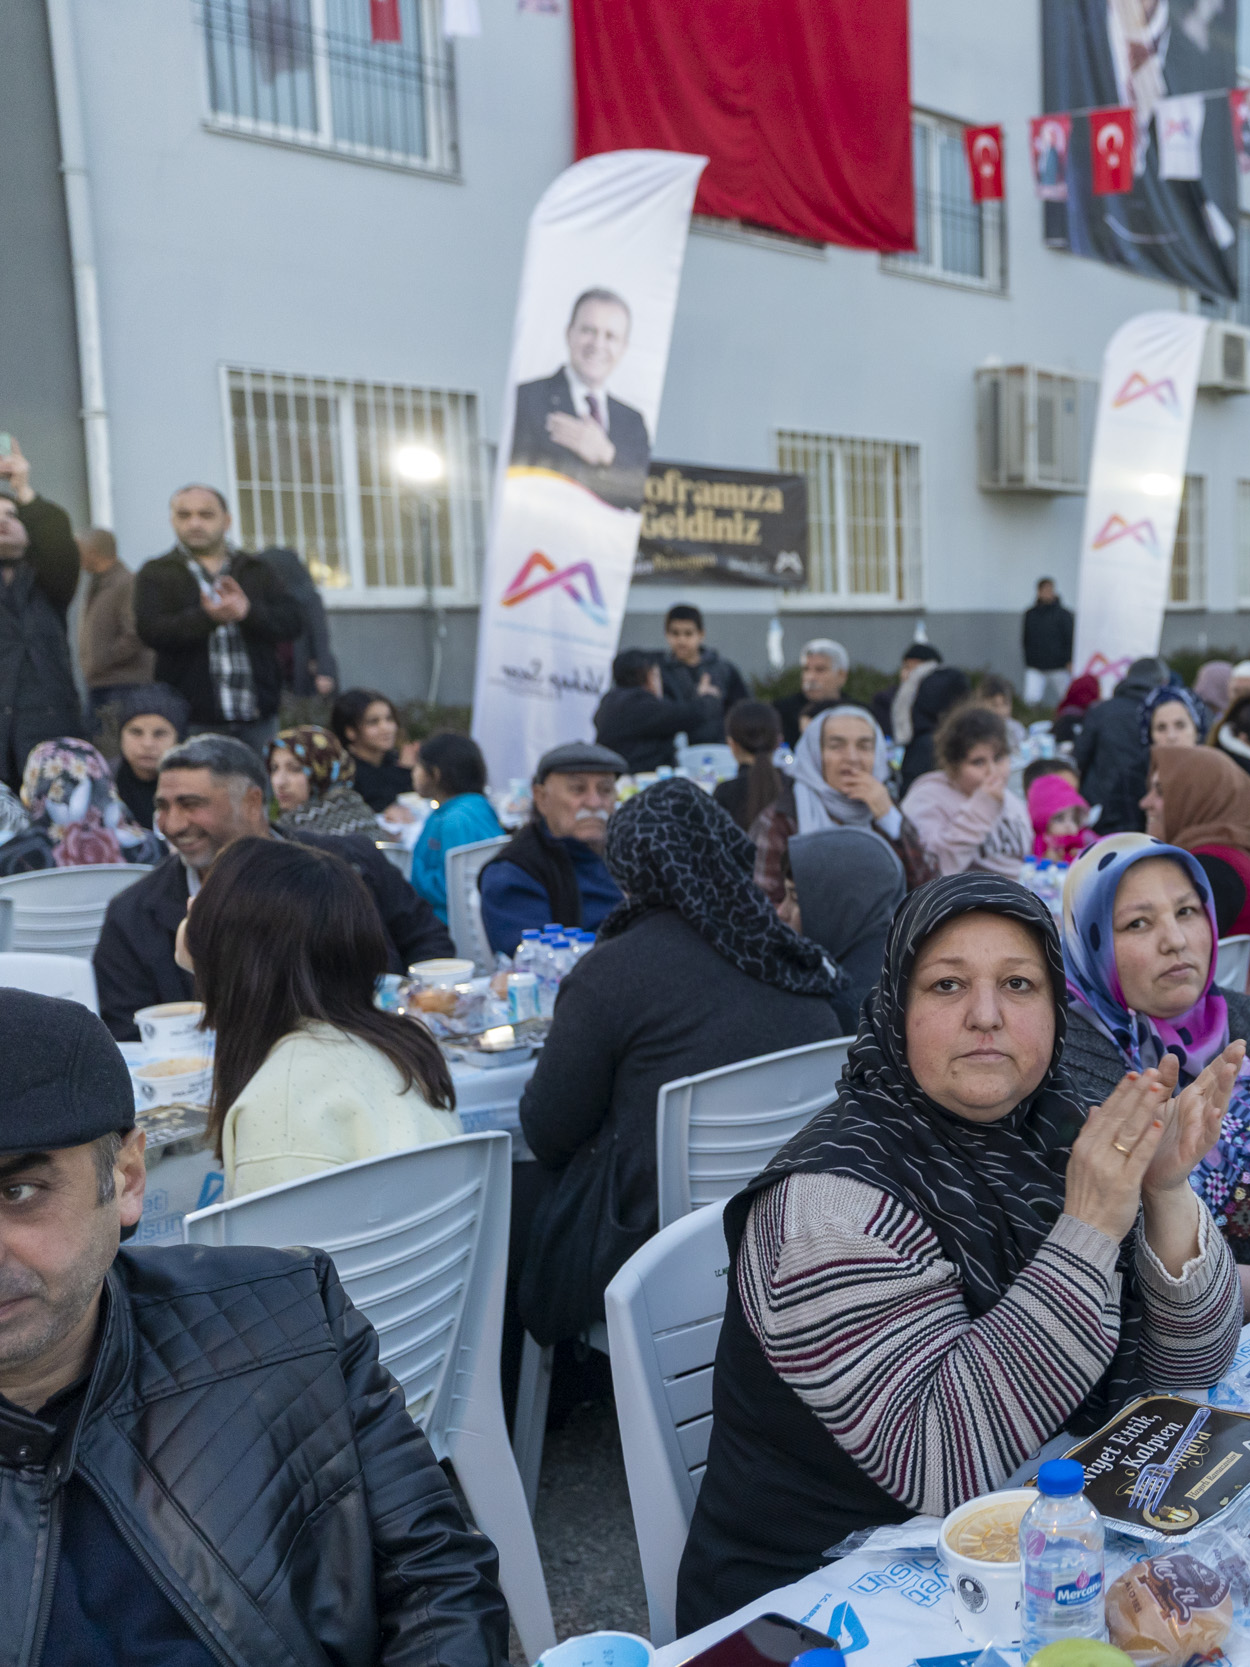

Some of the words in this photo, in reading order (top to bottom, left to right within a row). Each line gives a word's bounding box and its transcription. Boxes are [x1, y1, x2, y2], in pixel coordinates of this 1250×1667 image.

[644, 468, 784, 514] oframıza
[137, 1215, 183, 1241] lsun
[1108, 1413, 1163, 1447] Ettik,
[1119, 1420, 1184, 1469] Kalpten
[1057, 1583, 1098, 1602] Mercan
